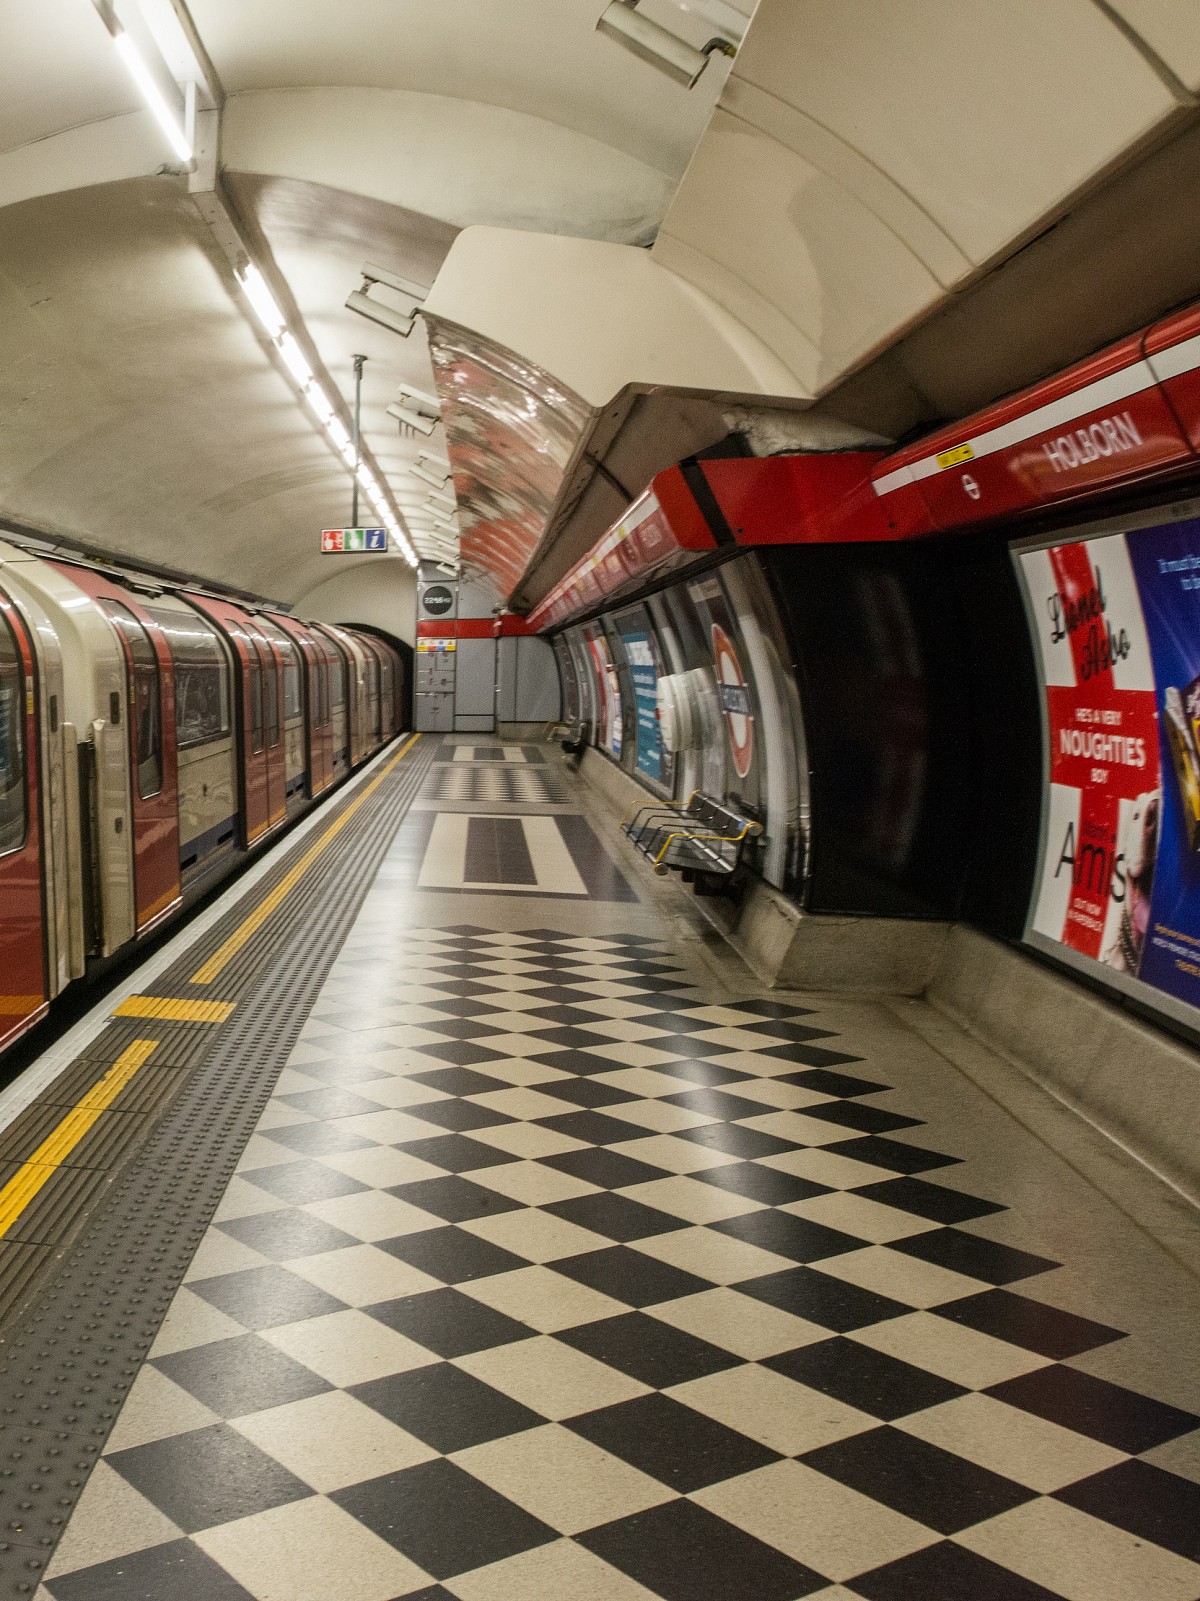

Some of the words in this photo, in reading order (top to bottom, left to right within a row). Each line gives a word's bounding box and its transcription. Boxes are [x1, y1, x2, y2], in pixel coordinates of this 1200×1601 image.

[1042, 411, 1142, 473] HOLBORN
[1060, 728, 1146, 768] NOUGHTIES
[1054, 821, 1127, 903] Amis
